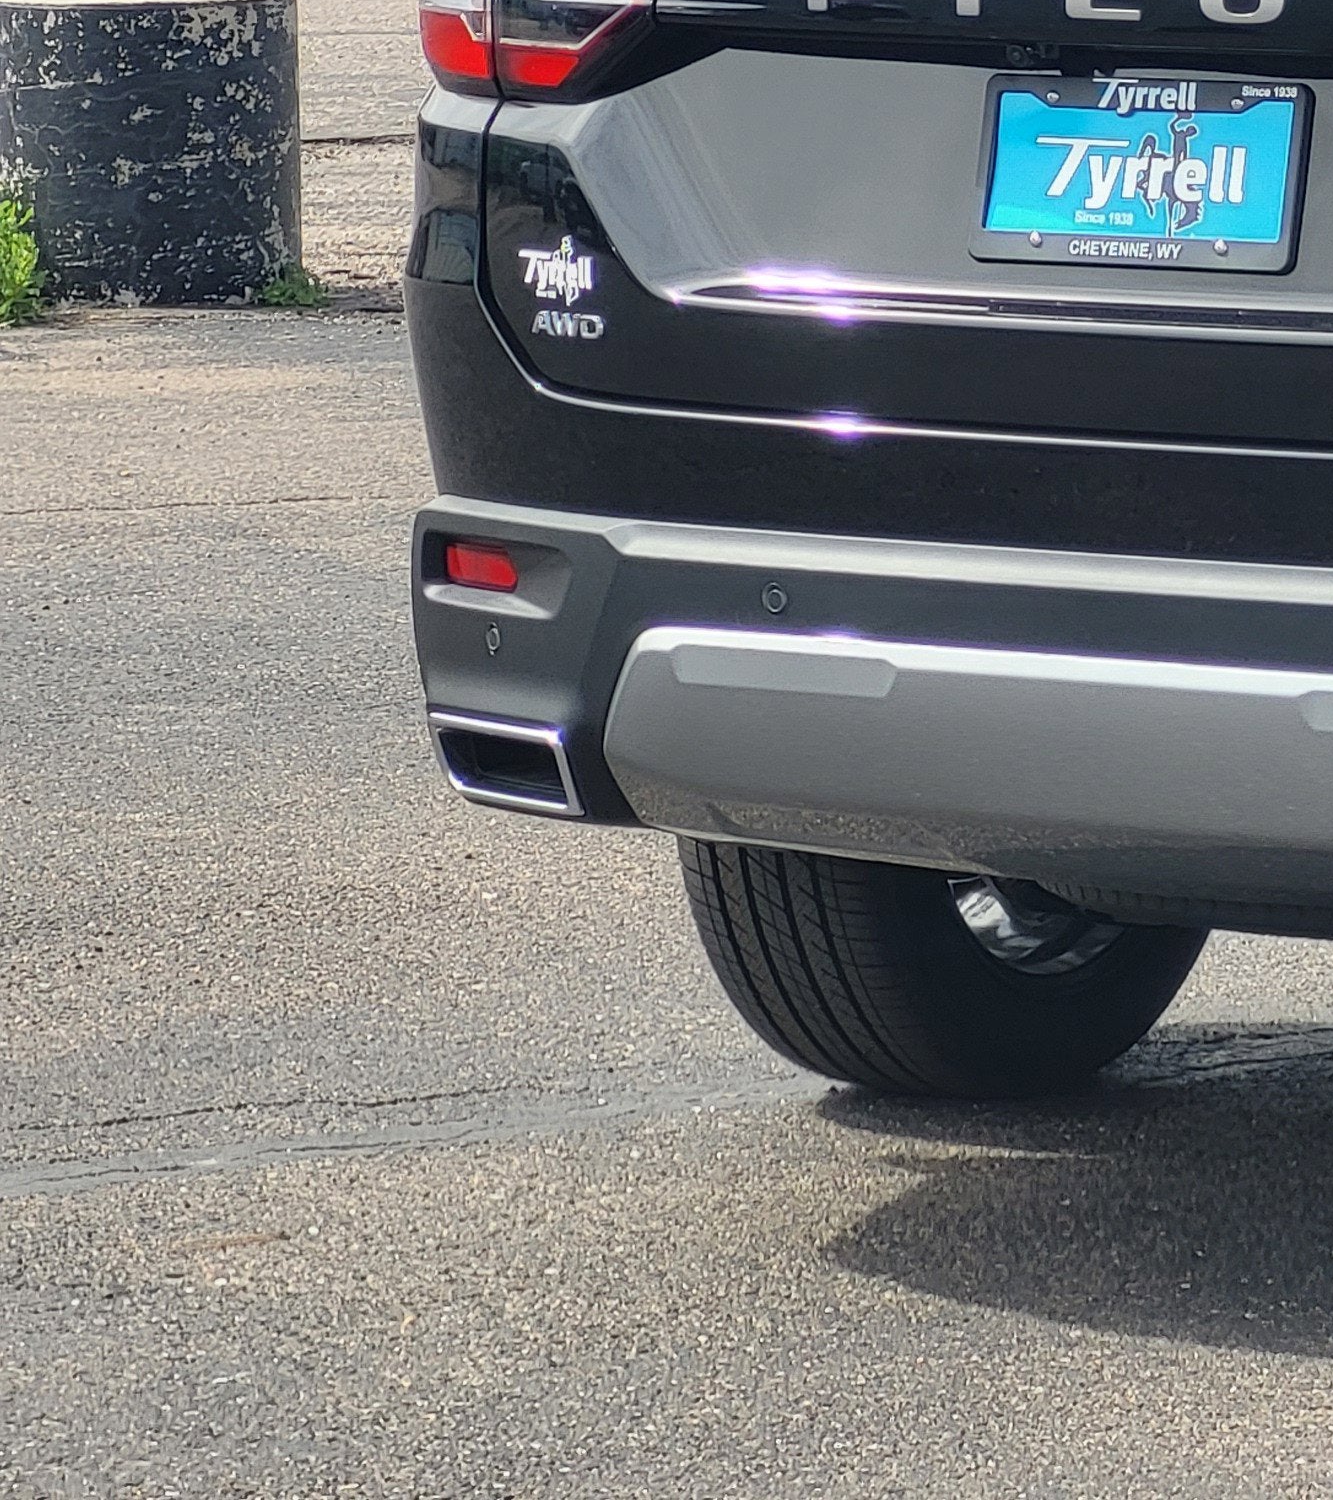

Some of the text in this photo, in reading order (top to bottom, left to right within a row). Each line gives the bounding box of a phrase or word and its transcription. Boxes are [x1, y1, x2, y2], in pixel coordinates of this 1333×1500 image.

[1092, 78, 1298, 114] Tyrrell Since 1938
[1036, 136, 1248, 209] Tyrrell
[1074, 210, 1106, 224] Since
[1069, 239, 1182, 261] CHEYENNE, WY
[532, 310, 604, 340] AWD
